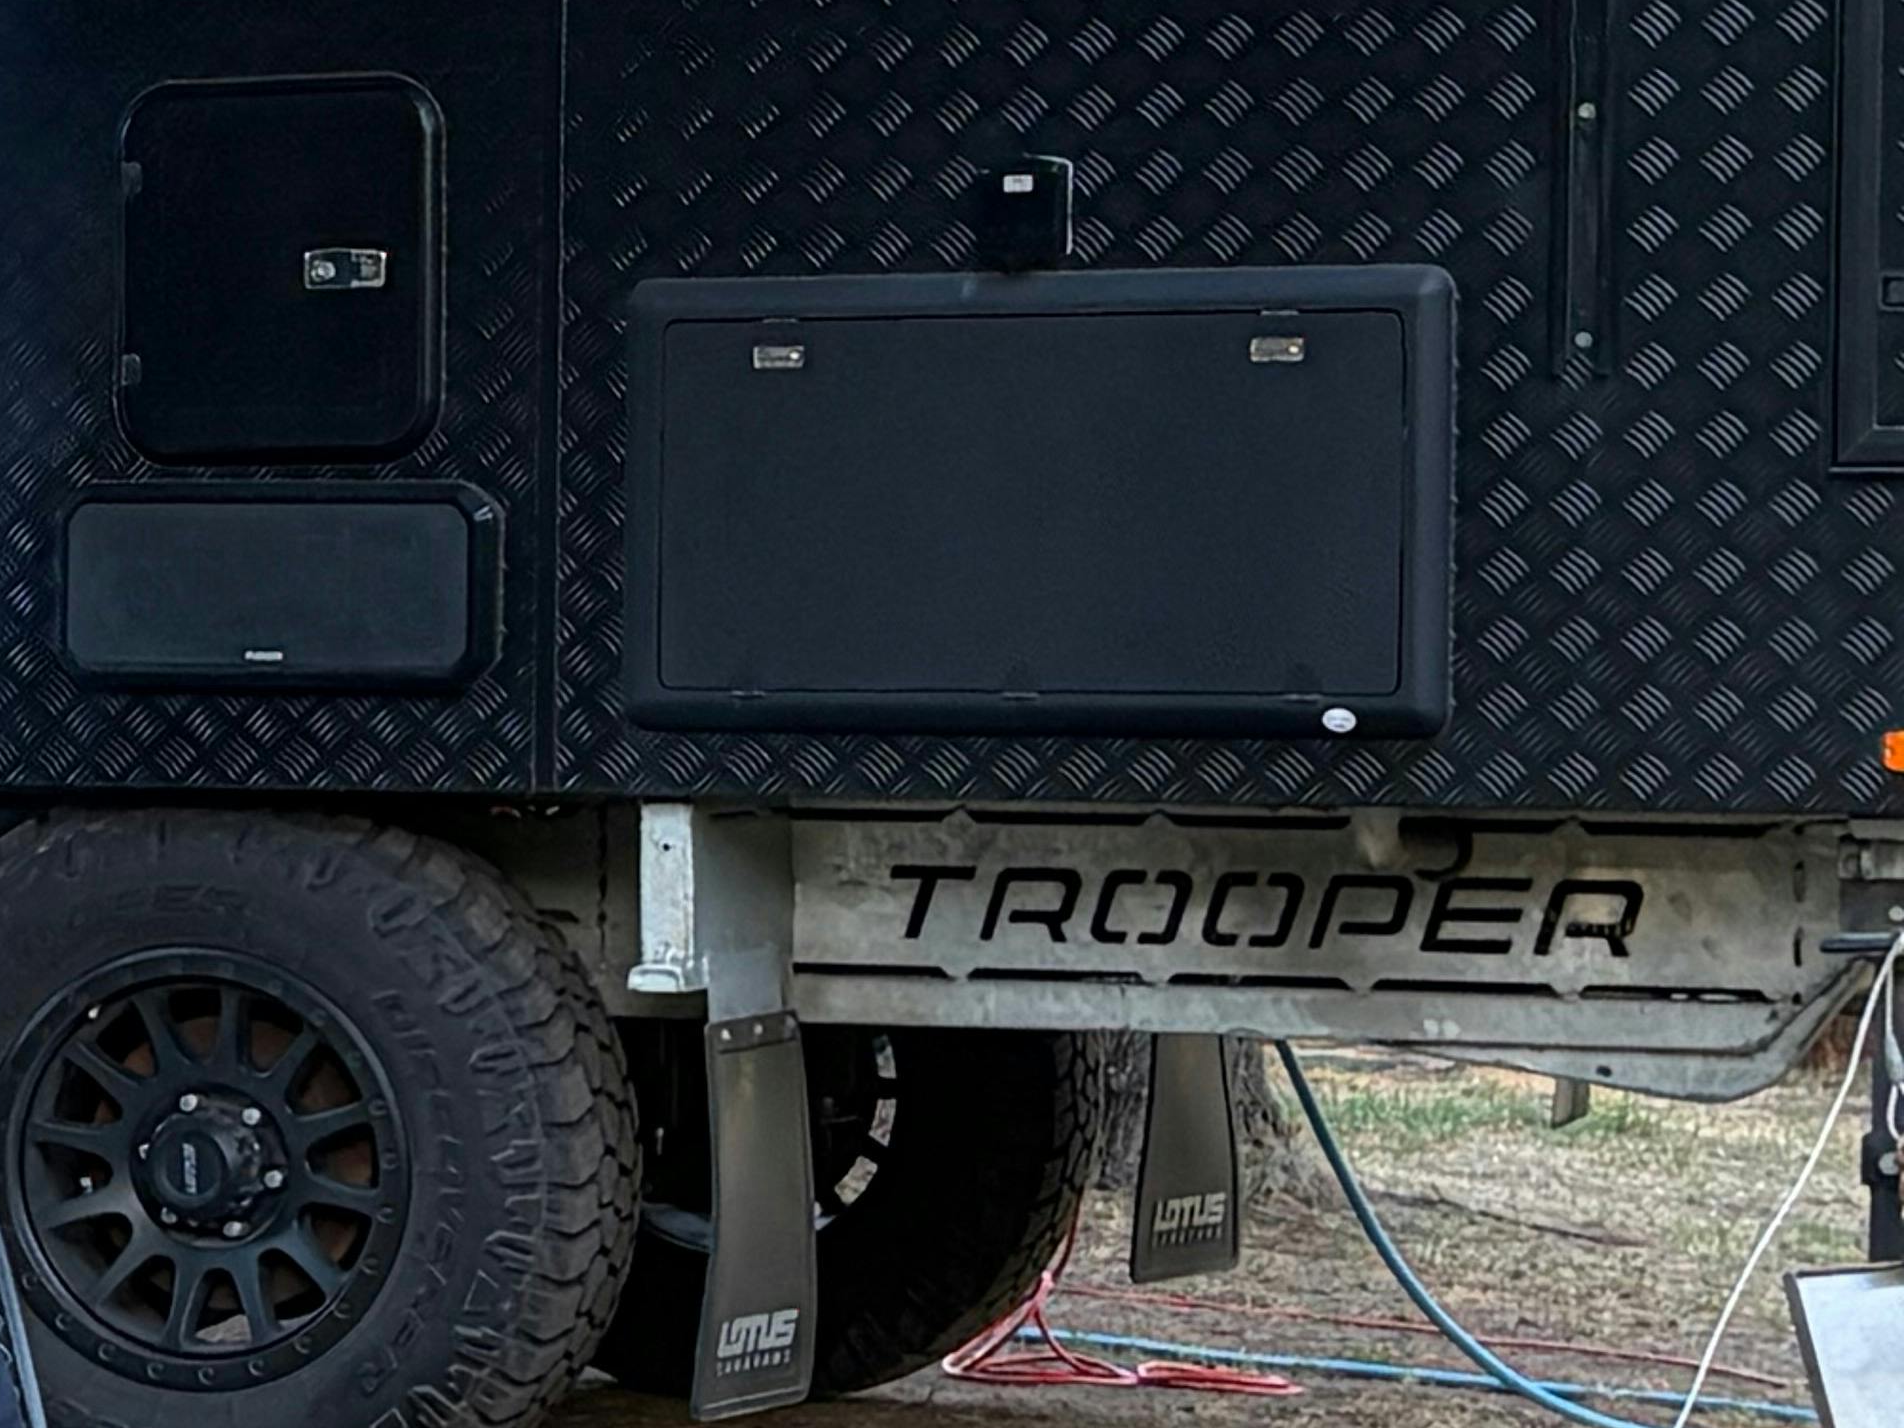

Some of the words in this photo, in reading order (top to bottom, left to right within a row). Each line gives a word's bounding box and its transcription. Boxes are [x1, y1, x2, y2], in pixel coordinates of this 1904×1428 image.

[889, 864, 1647, 959] TROOPER
[1153, 1192, 1227, 1233] LOTUS
[717, 1309, 800, 1359] LOTUS
